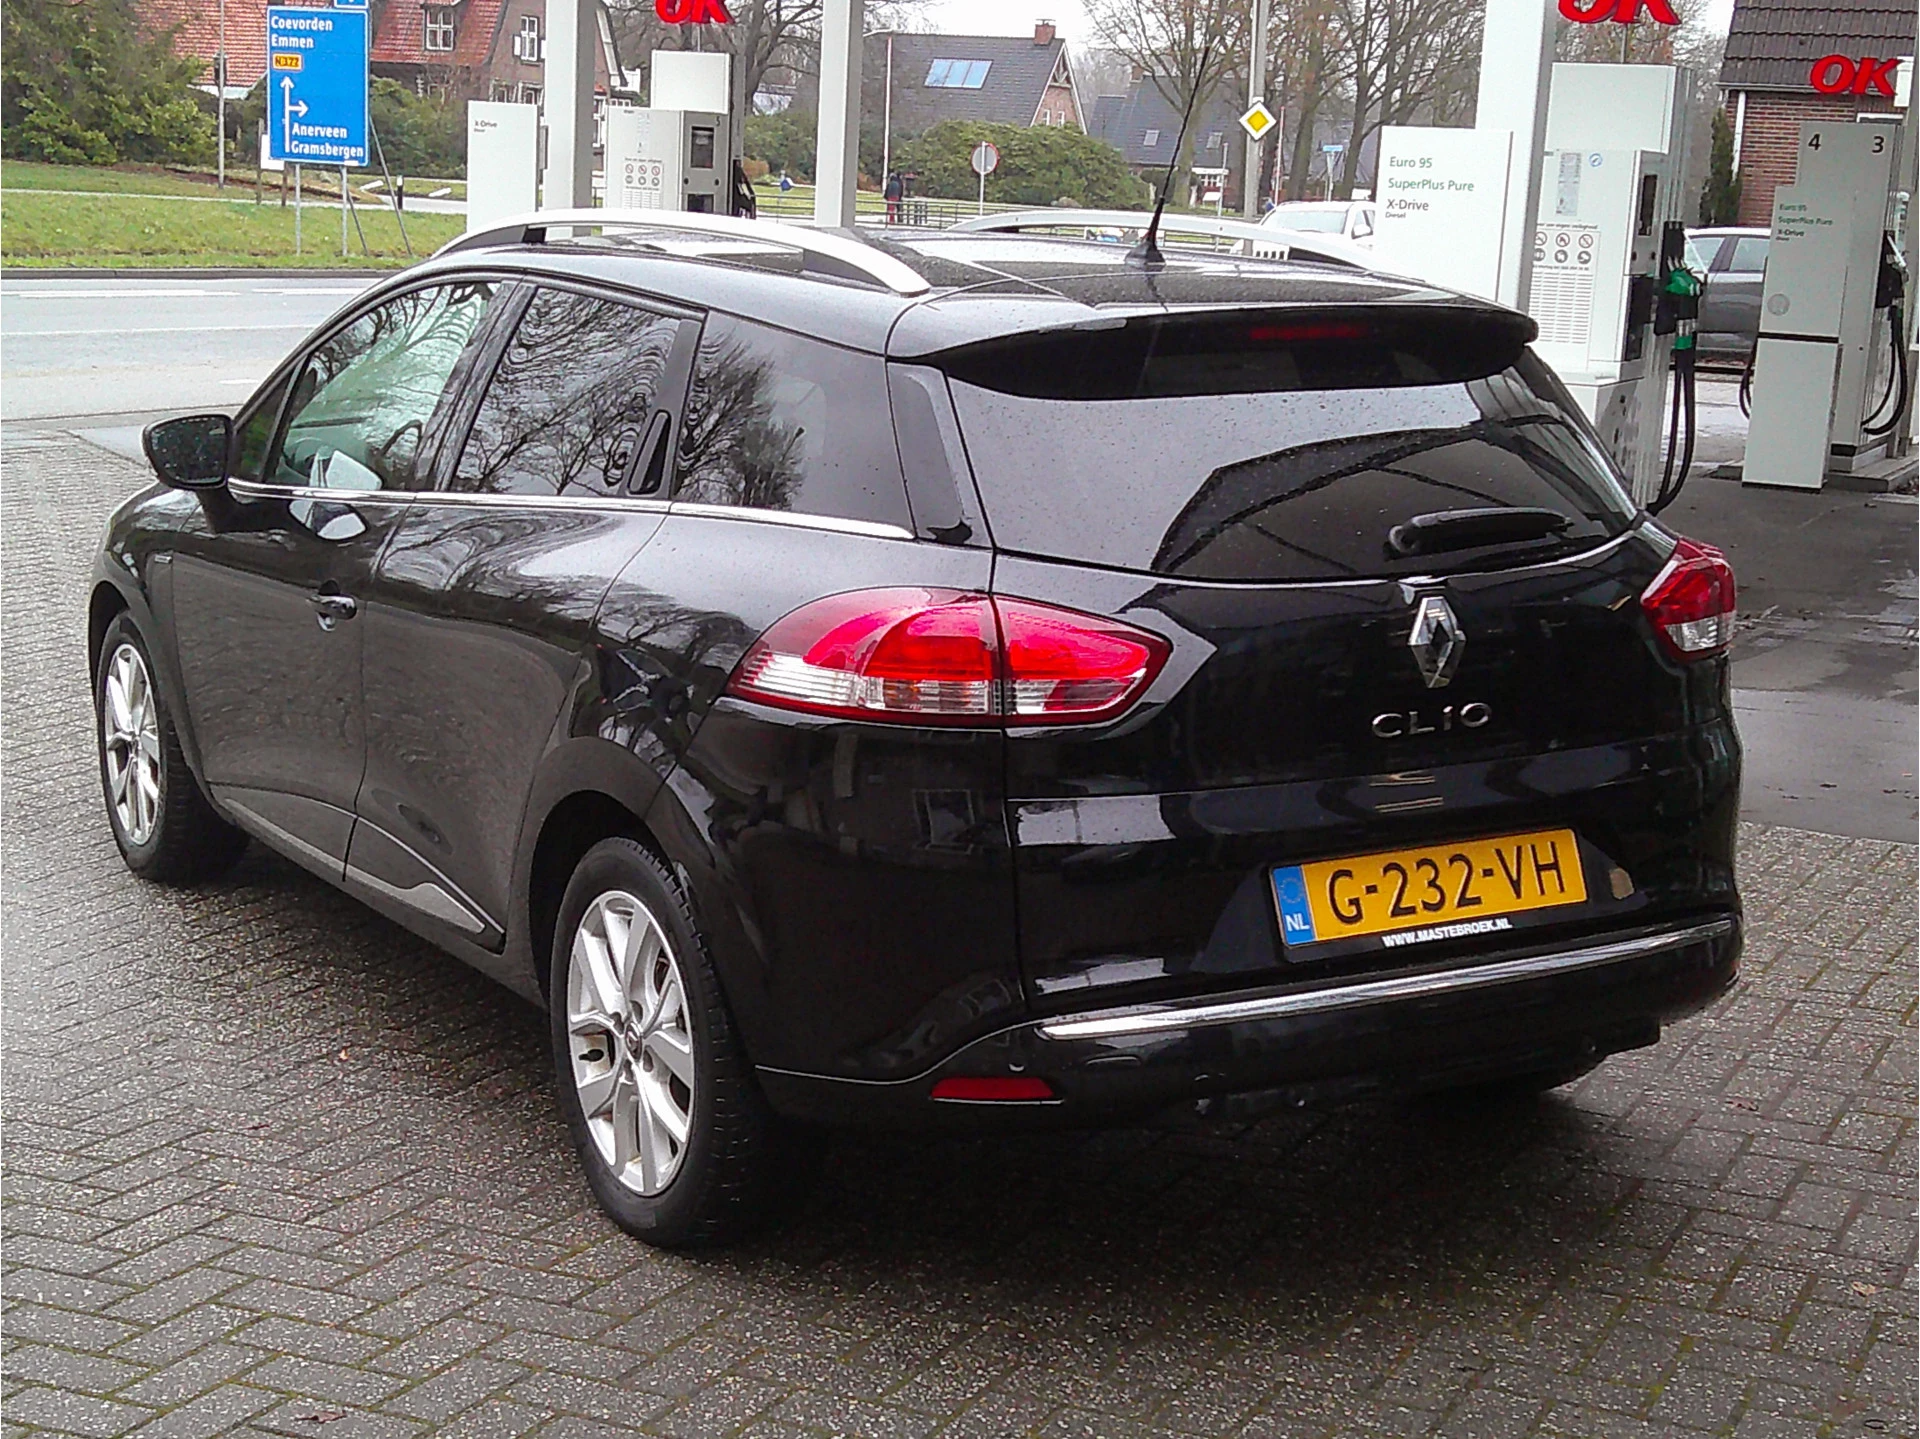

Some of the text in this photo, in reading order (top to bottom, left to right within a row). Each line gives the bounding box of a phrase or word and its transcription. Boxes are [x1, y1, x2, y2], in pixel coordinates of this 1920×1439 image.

[271, 15, 333, 31] Coevorden
[271, 34, 314, 48] Emmen
[1810, 54, 1902, 96] OK
[292, 122, 348, 138] Anerveen
[291, 141, 364, 159] Gramsbergen
[1807, 133, 1822, 150] 4
[1871, 135, 1885, 153] 3
[1389, 156, 1433, 168] Euro 95
[1388, 177, 1475, 192] SuperPlus Pure
[1386, 198, 1429, 211] X-Drive
[1328, 841, 1565, 925] G-232-VH
[1286, 914, 1310, 931] NL
[1381, 917, 1513, 948] WWW.MASTEBROEK.NL
